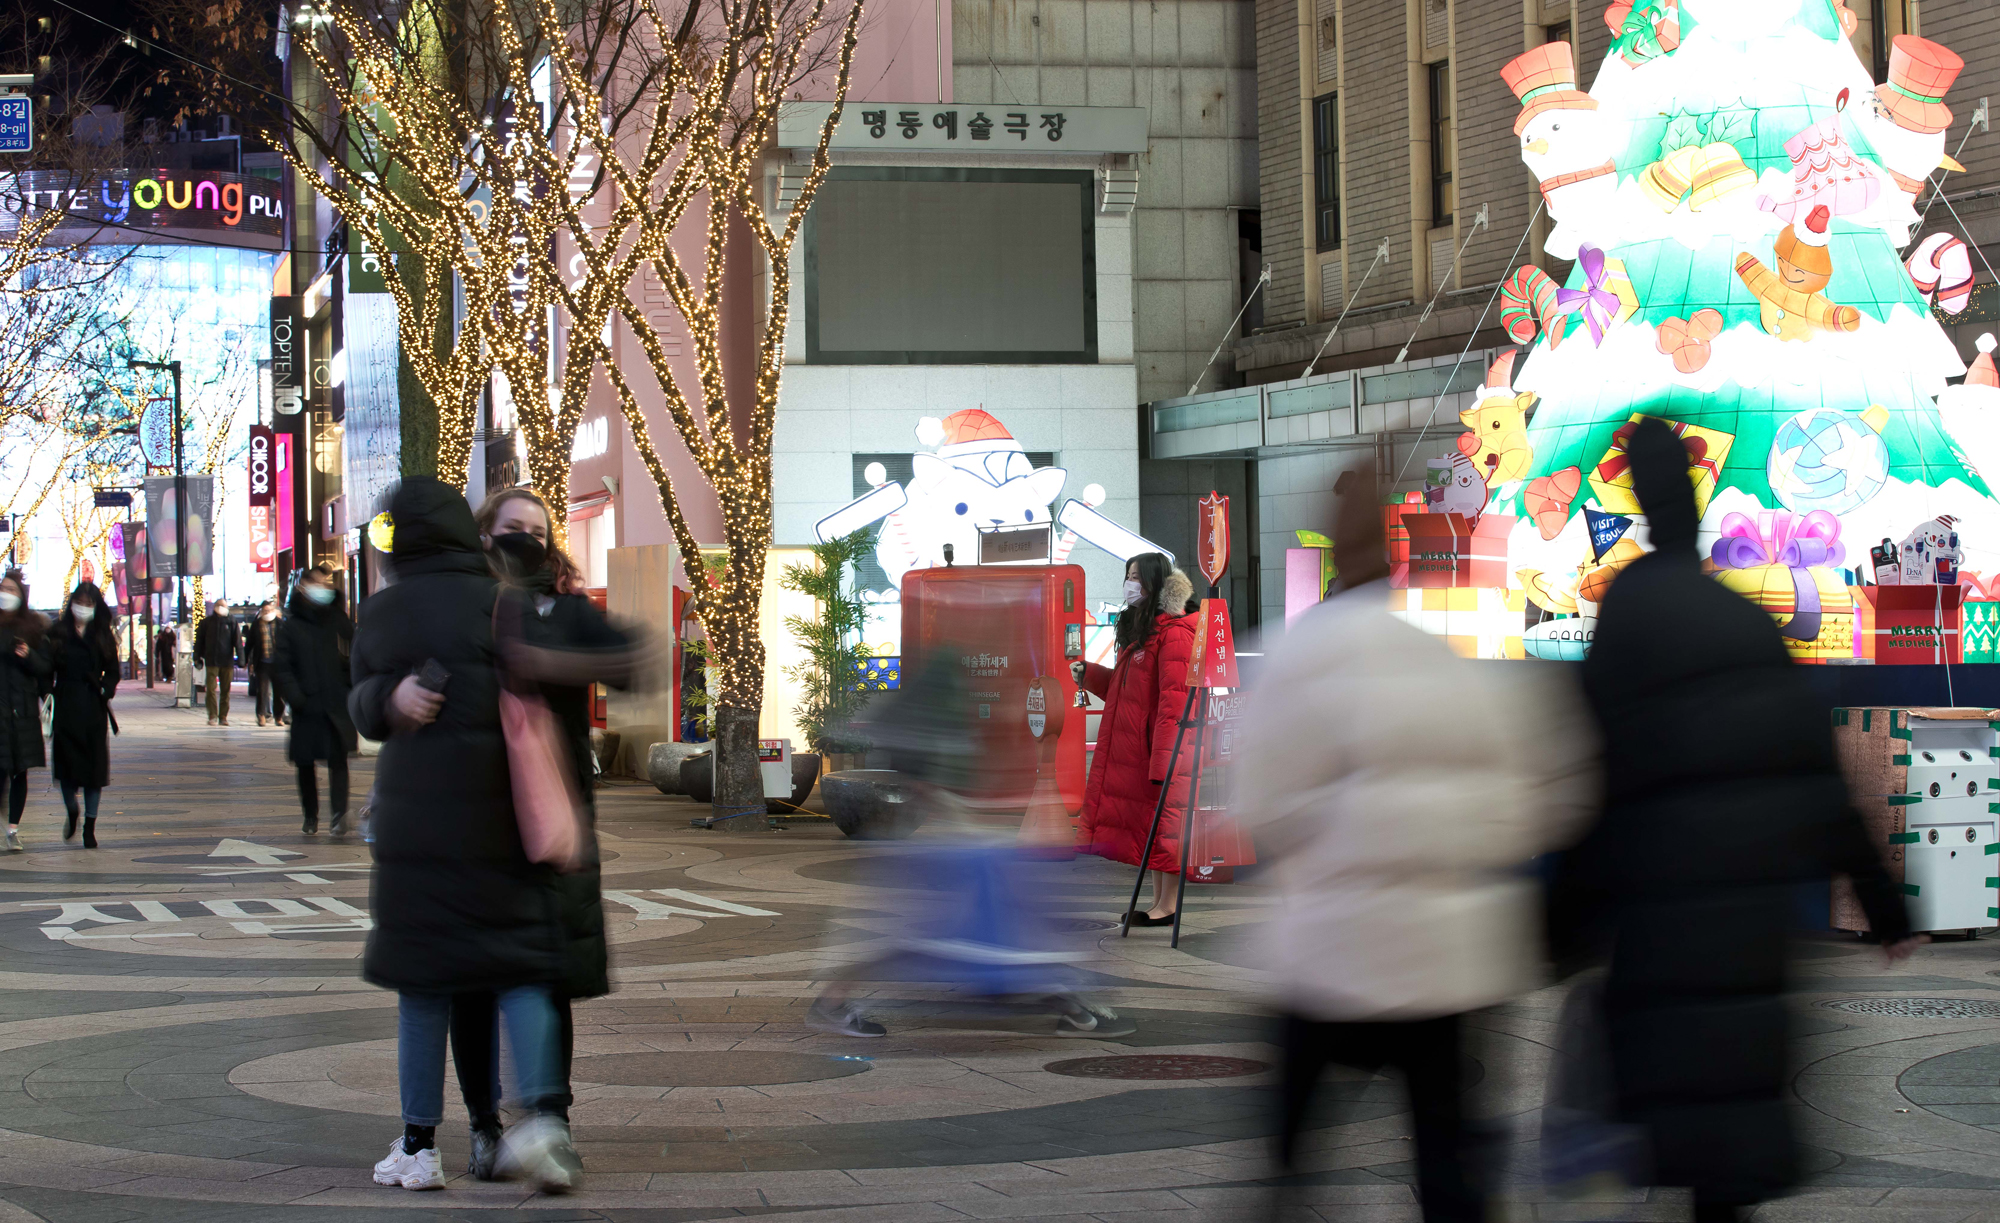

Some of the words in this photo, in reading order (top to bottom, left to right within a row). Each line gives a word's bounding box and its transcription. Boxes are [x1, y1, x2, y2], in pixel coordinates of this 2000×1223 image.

[861, 109, 1068, 142] 명동예술극장
[101, 178, 243, 227] young
[251, 435, 269, 495] CHICOR
[1591, 516, 1617, 532] VISIT
[1595, 527, 1624, 547] SEOUL
[1206, 504, 1217, 574] 구세군
[1418, 564, 1461, 572] MEDIHEAL
[1420, 550, 1459, 562] MERRY
[1193, 611, 1207, 677] 자선냄비
[1213, 611, 1228, 678] 자선냄비
[1888, 639, 1945, 648] MEDIHEAL
[1890, 624, 1943, 637] MERRY
[1208, 696, 1226, 722] NO
[20, 888, 783, 941] 진입지
